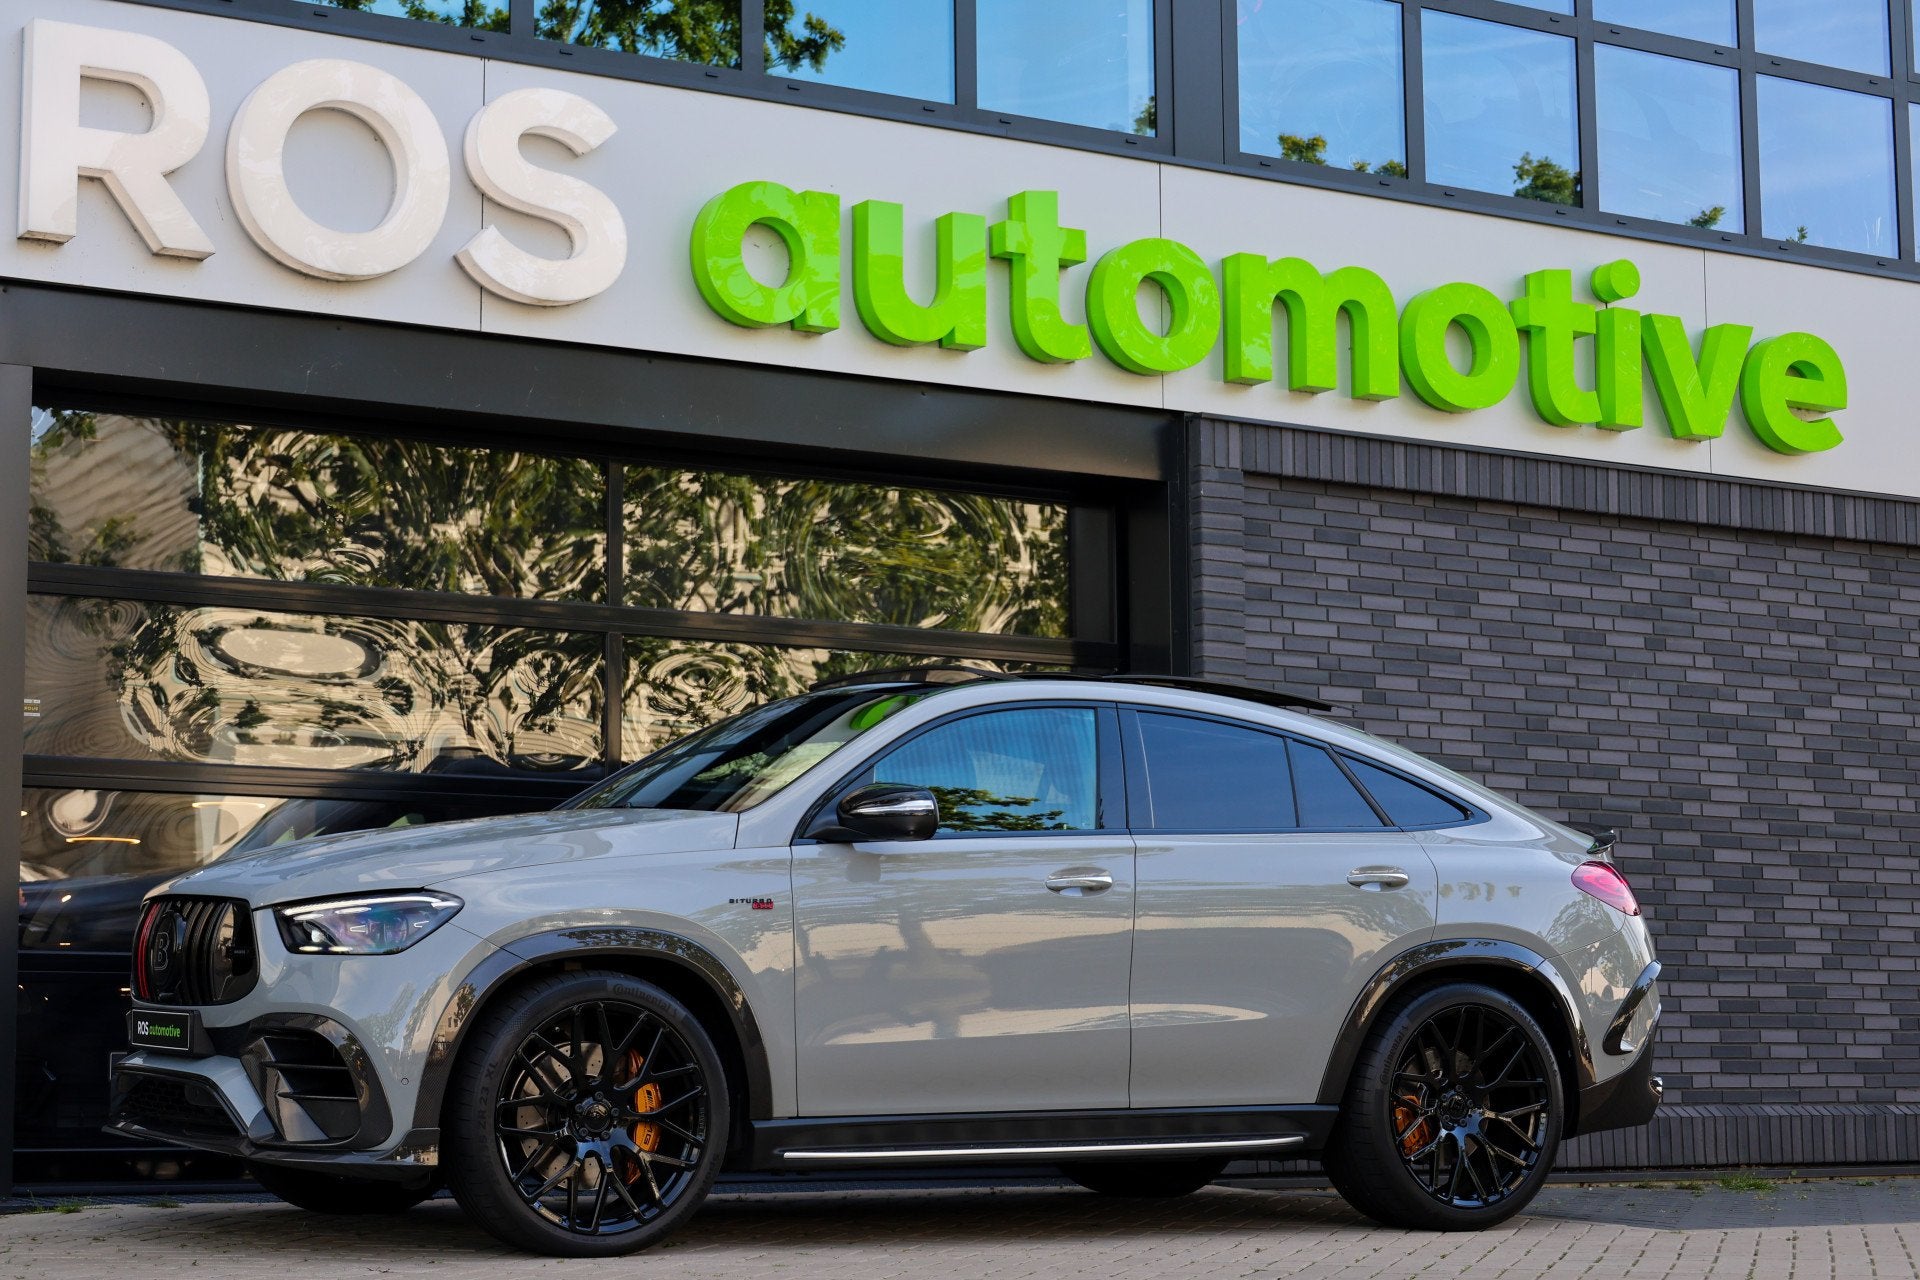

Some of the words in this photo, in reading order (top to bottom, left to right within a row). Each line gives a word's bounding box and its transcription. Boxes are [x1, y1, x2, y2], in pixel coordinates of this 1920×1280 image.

[17, 18, 628, 307] ROS
[690, 181, 1848, 456] automotive
[137, 1020, 149, 1036] ROS
[149, 1024, 181, 1038] automotive
